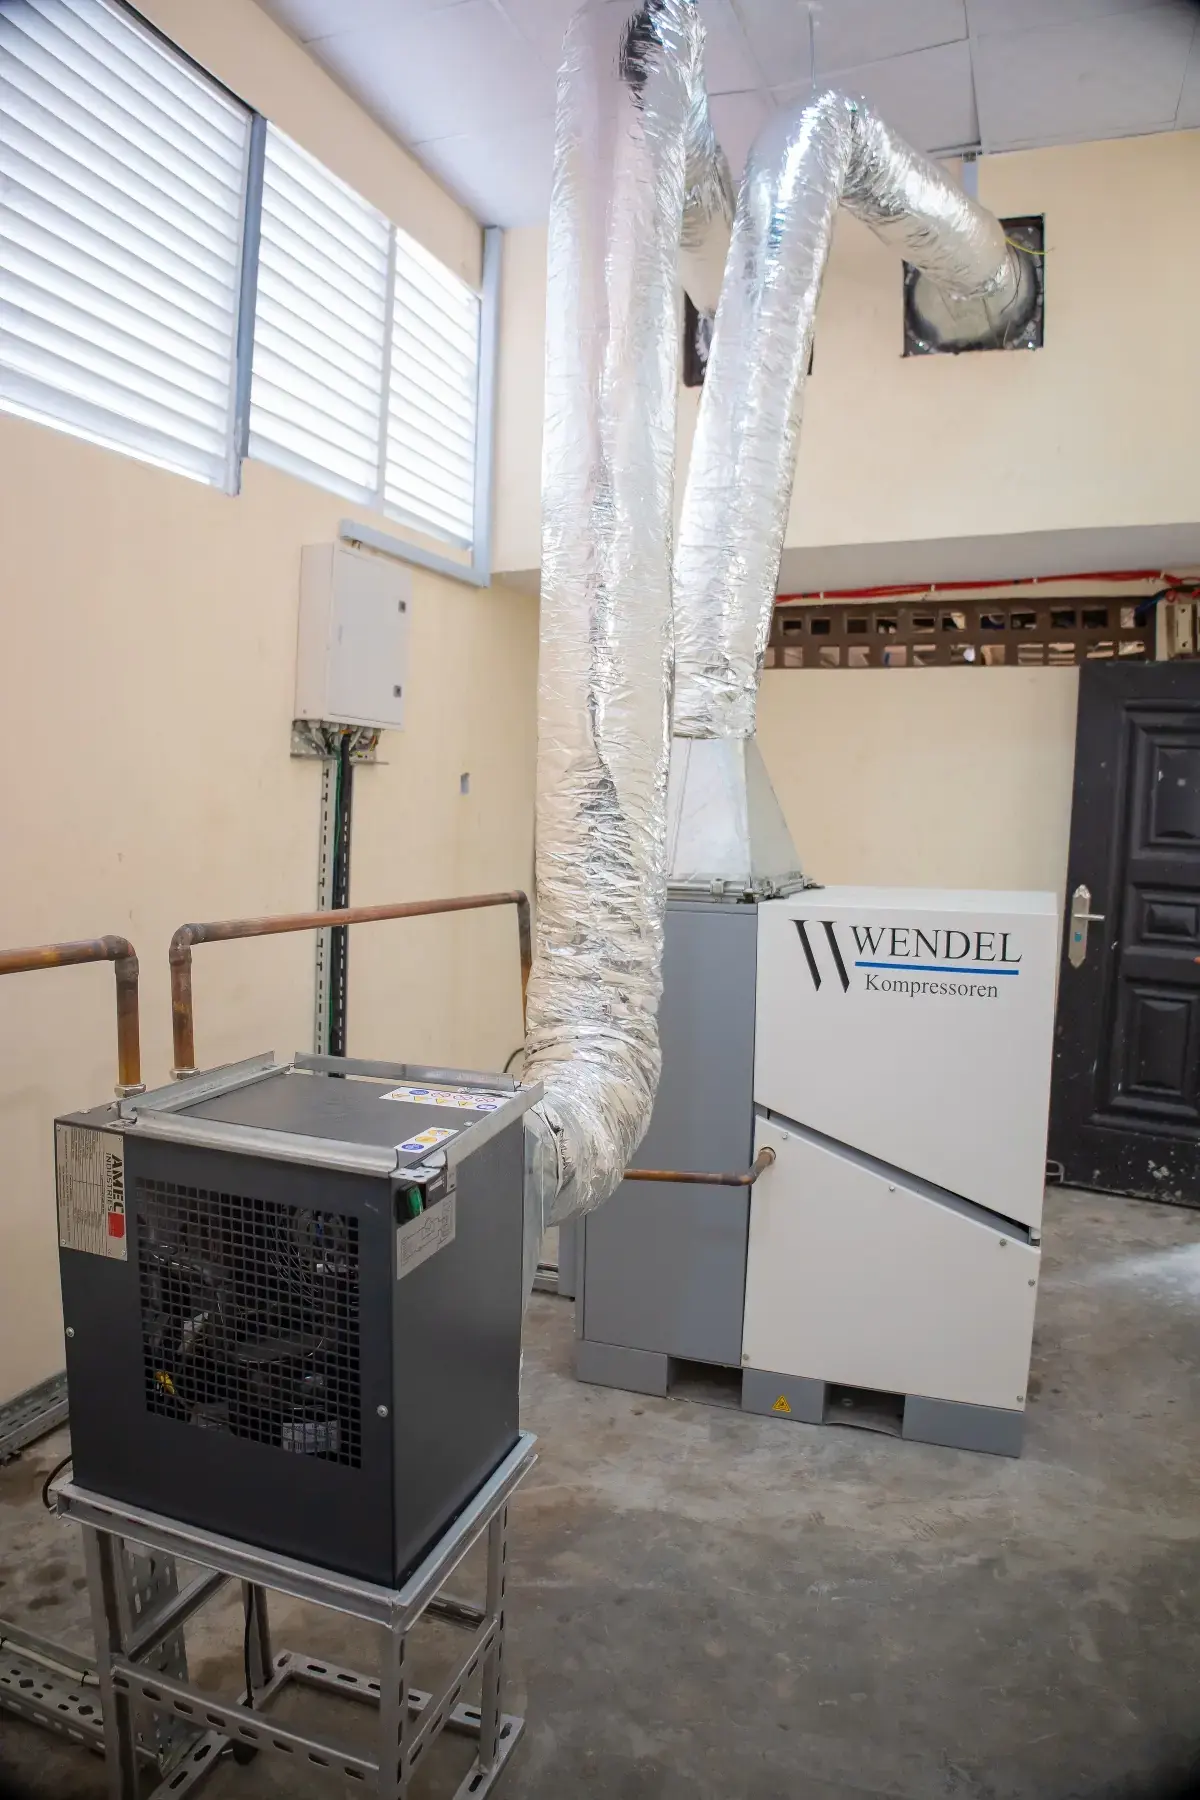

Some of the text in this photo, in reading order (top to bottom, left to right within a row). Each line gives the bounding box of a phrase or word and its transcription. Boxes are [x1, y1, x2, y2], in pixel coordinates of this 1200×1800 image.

[849, 925, 1023, 963] WENDEL
[864, 973, 998, 998] Kompressoren
[105, 1152, 114, 1212] INDUSTRIES
[111, 1153, 124, 1214] AMEC
